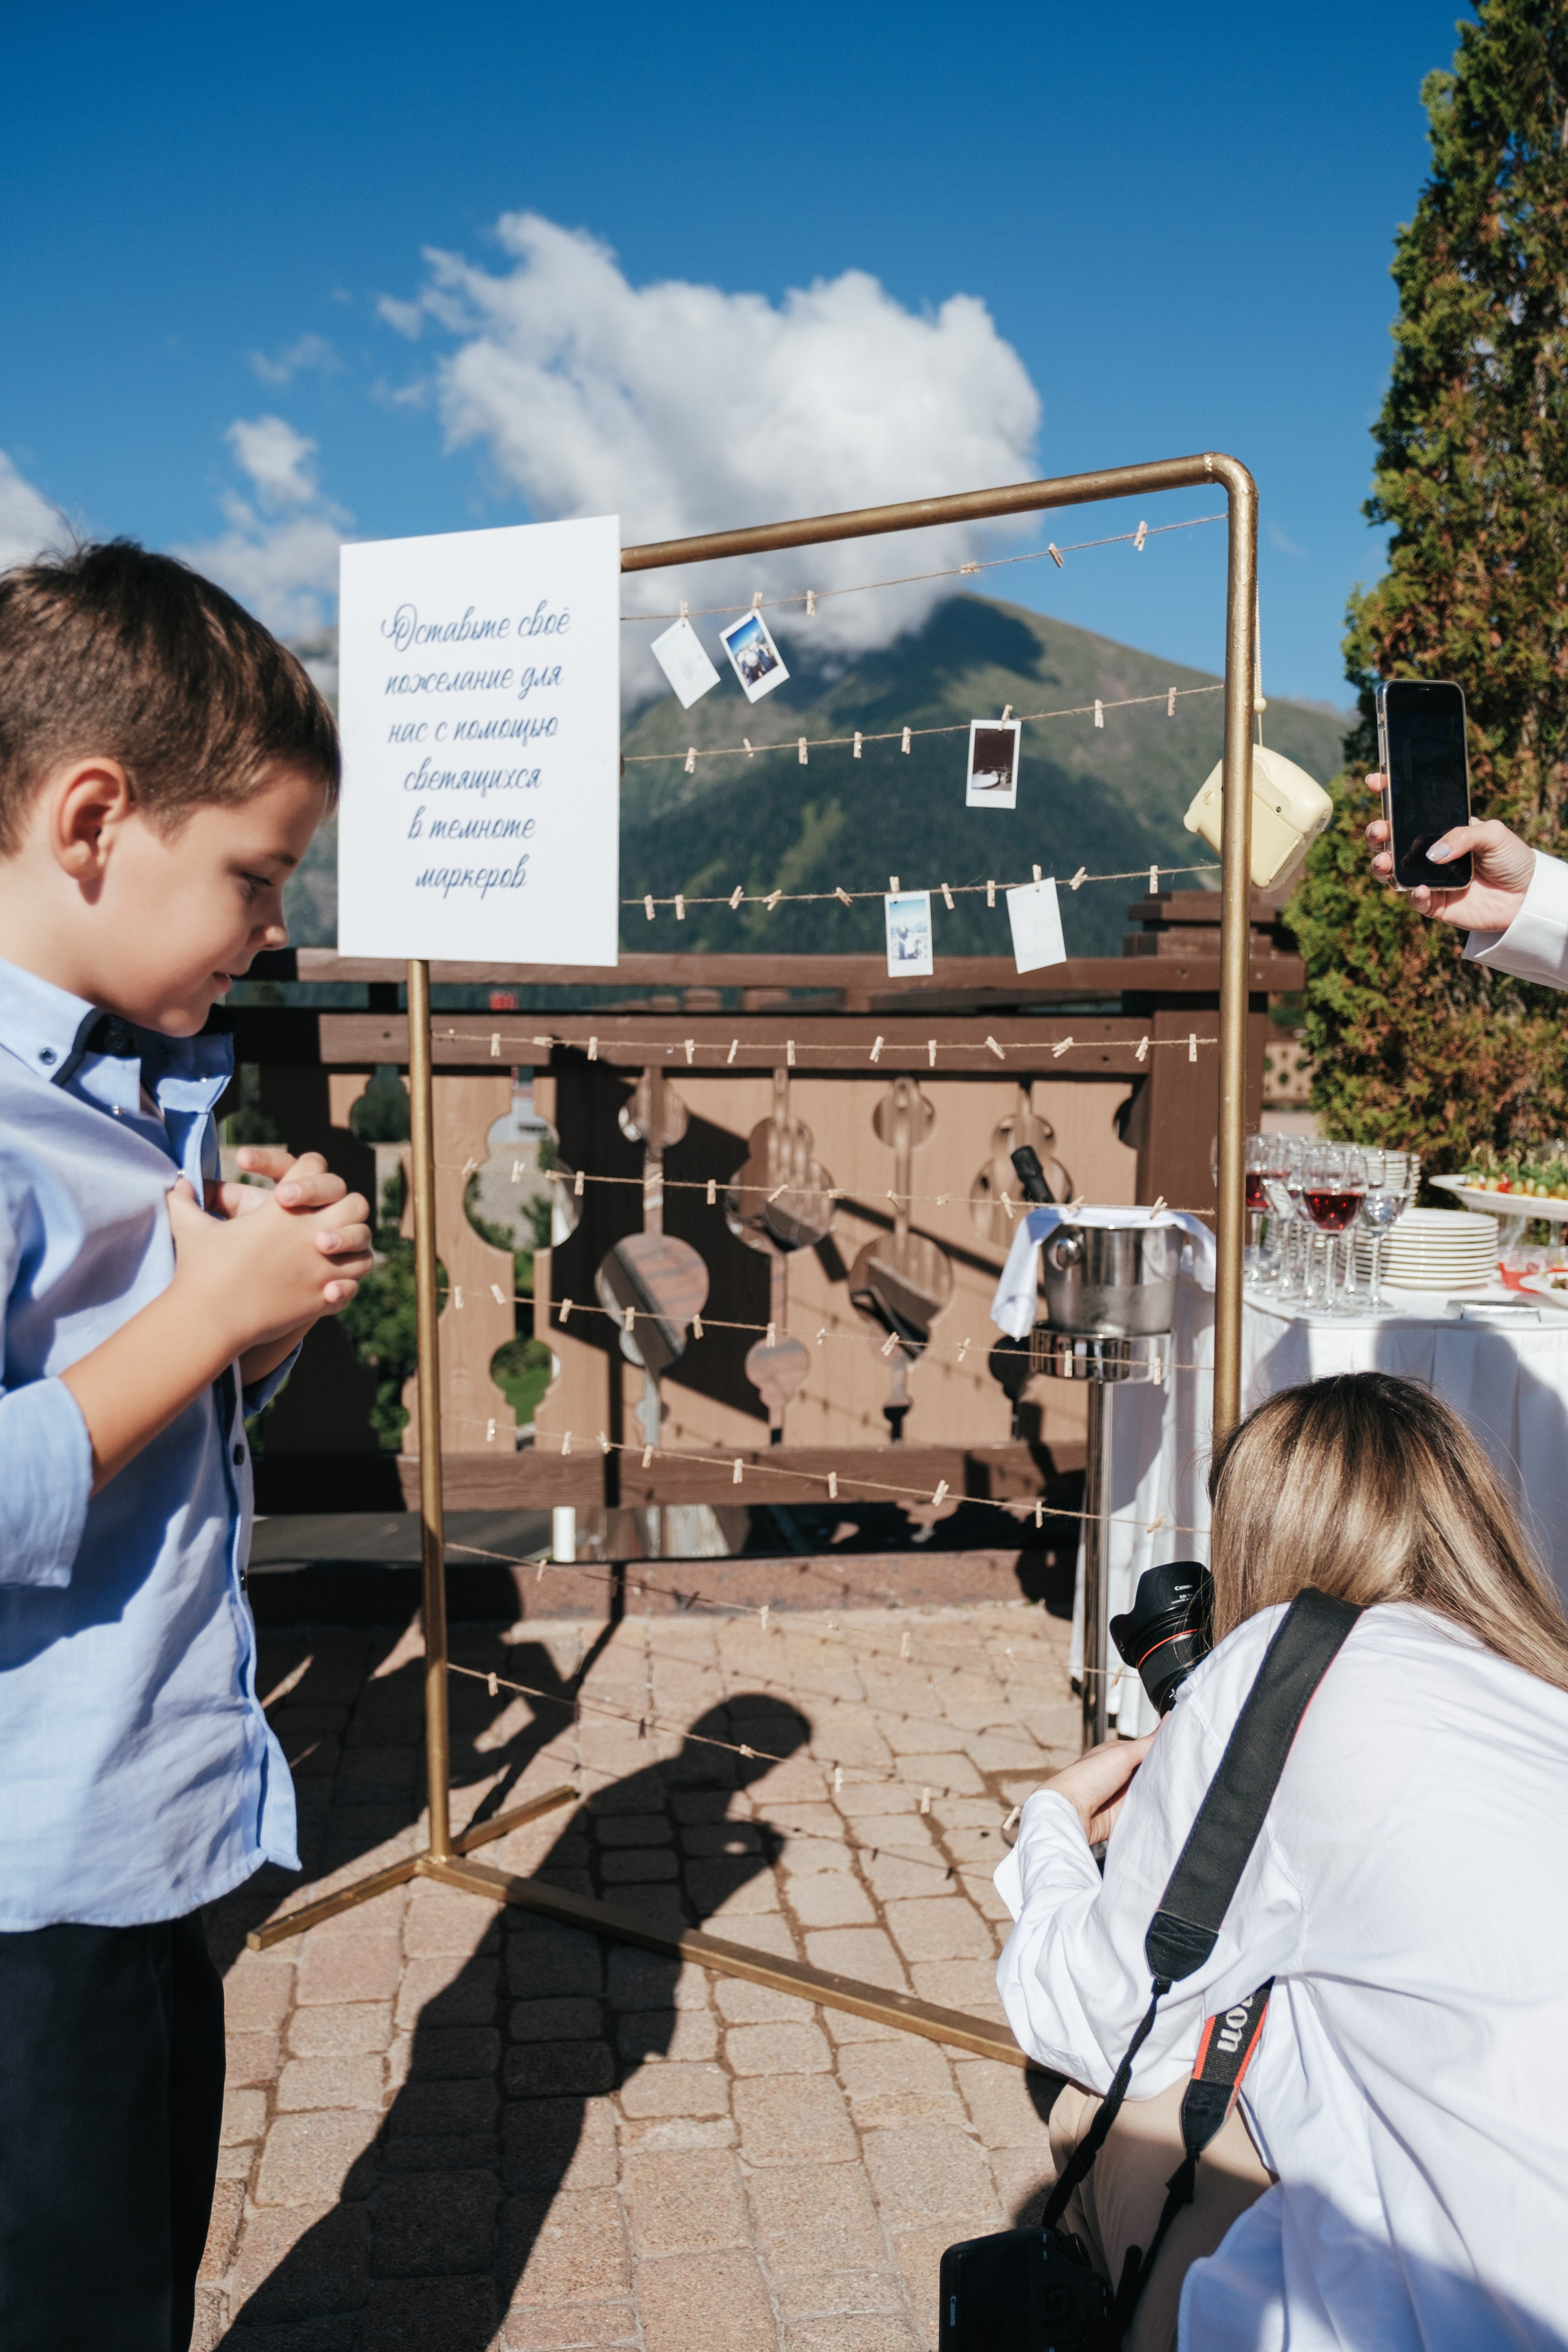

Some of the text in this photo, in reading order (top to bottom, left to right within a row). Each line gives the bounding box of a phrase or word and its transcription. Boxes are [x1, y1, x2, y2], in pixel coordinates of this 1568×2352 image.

[380, 599, 571, 653] Оставьте своё
[384, 665, 563, 701] пожелание для
[388, 716, 559, 747] нас с помощью
[404, 756, 542, 798] светящихся
[407, 805, 536, 840] в темноте
[415, 853, 531, 900] маркеров
